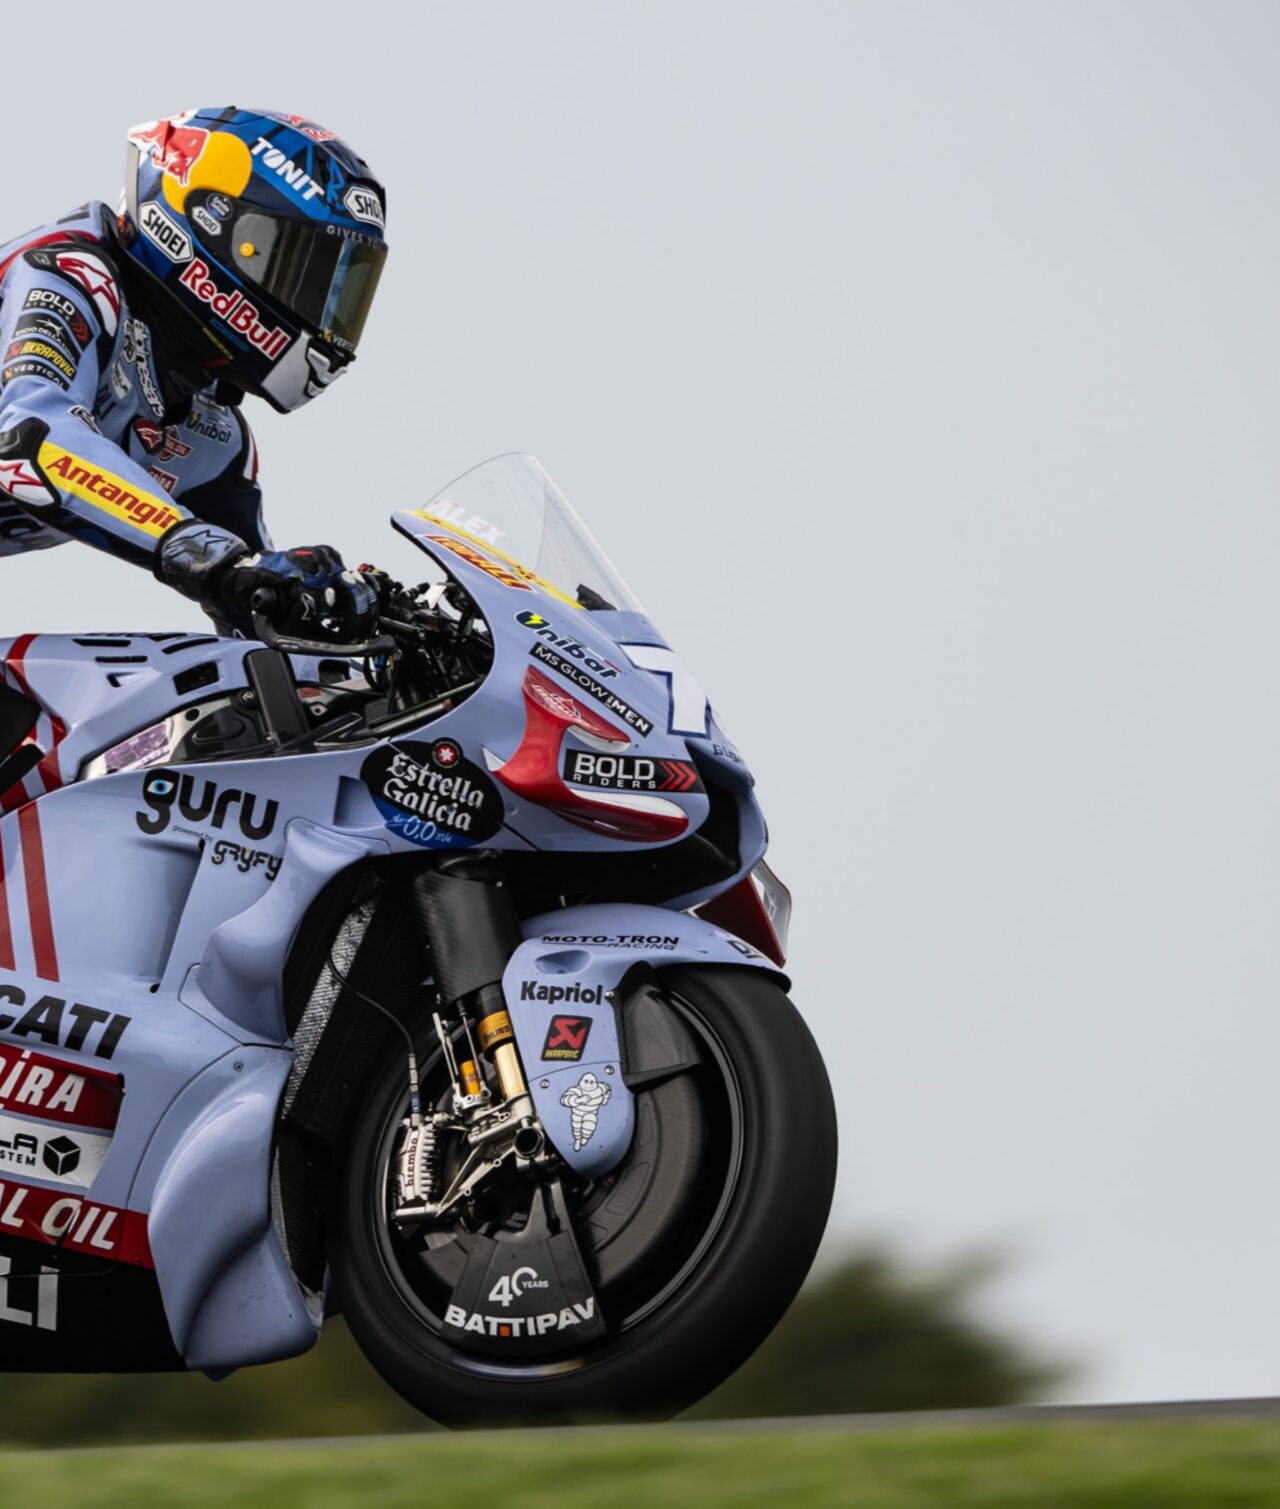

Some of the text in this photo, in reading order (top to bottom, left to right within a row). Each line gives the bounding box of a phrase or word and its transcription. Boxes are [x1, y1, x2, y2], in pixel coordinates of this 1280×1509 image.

[353, 193, 383, 219] SHO
[141, 207, 188, 257] SHOEI
[195, 209, 219, 234] SHOEI
[326, 224, 365, 243] GIVES
[25, 301, 72, 321] RIDERS
[28, 289, 76, 316] BOLD
[180, 258, 242, 320] Red
[228, 293, 293, 361] Bull
[13, 363, 65, 387] VERTICAL
[185, 410, 233, 446] Unibat
[514, 609, 622, 680] Unibat
[535, 644, 559, 666] MS
[560, 662, 608, 698] GLOW
[574, 752, 656, 781] BOLD
[385, 752, 486, 810] Estrella
[573, 772, 657, 790] RIDERS
[135, 767, 280, 841] guru
[383, 777, 473, 832] Galicia
[172, 824, 205, 841] powered
[541, 934, 680, 945] MOTO-TRON
[605, 942, 677, 951] RACING
[520, 980, 604, 1005] Kapriol
[404, 1137, 419, 1188] brembo
[40, 1197, 119, 1251] OIL
[521, 1279, 550, 1289] YEARS
[443, 1296, 597, 1338] BATTIPAV
